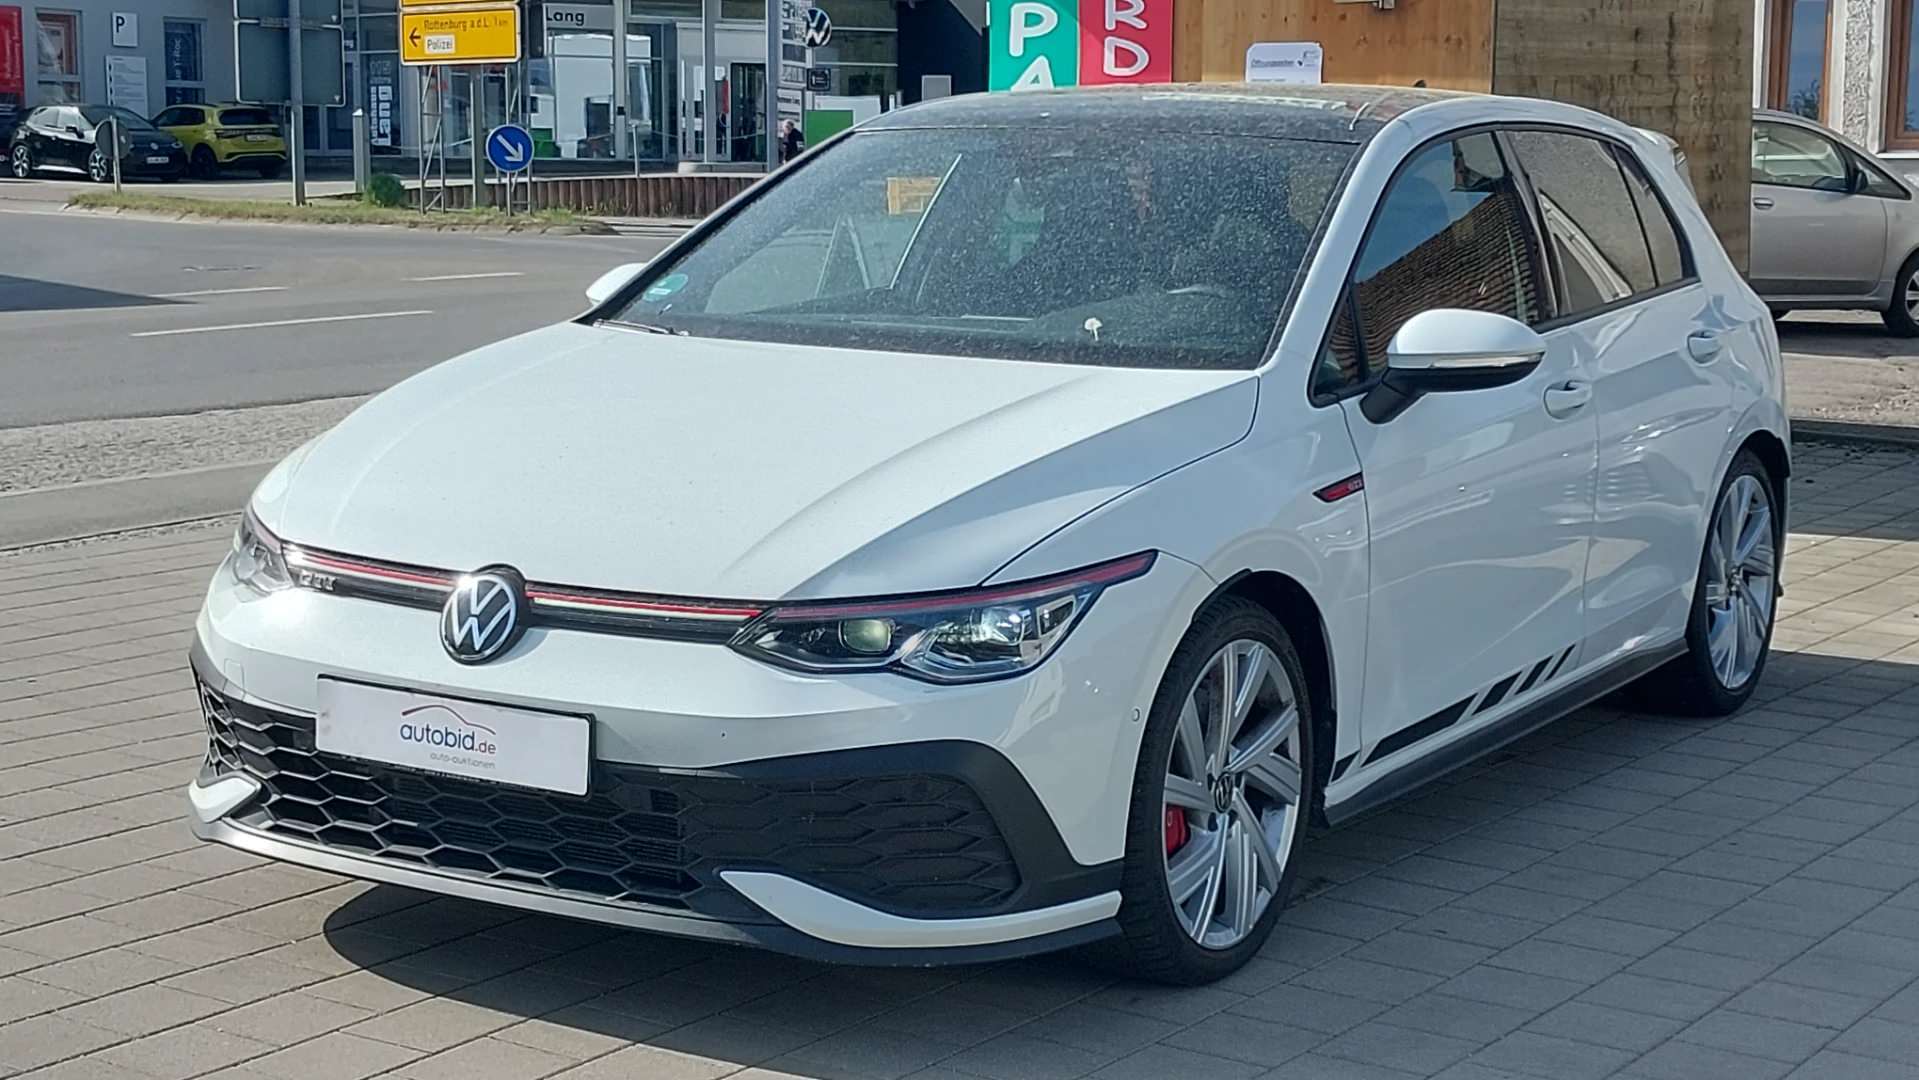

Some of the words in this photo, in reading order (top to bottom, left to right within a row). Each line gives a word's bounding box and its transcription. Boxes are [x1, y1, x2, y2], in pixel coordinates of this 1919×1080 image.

[115, 15, 126, 33] P
[423, 18, 468, 32] Rottenburg
[546, 6, 585, 26] Lang
[427, 39, 453, 50] Polizei
[377, 85, 393, 146] Lang
[399, 723, 497, 755] autobid.de
[430, 752, 496, 769] auto-auktionen
